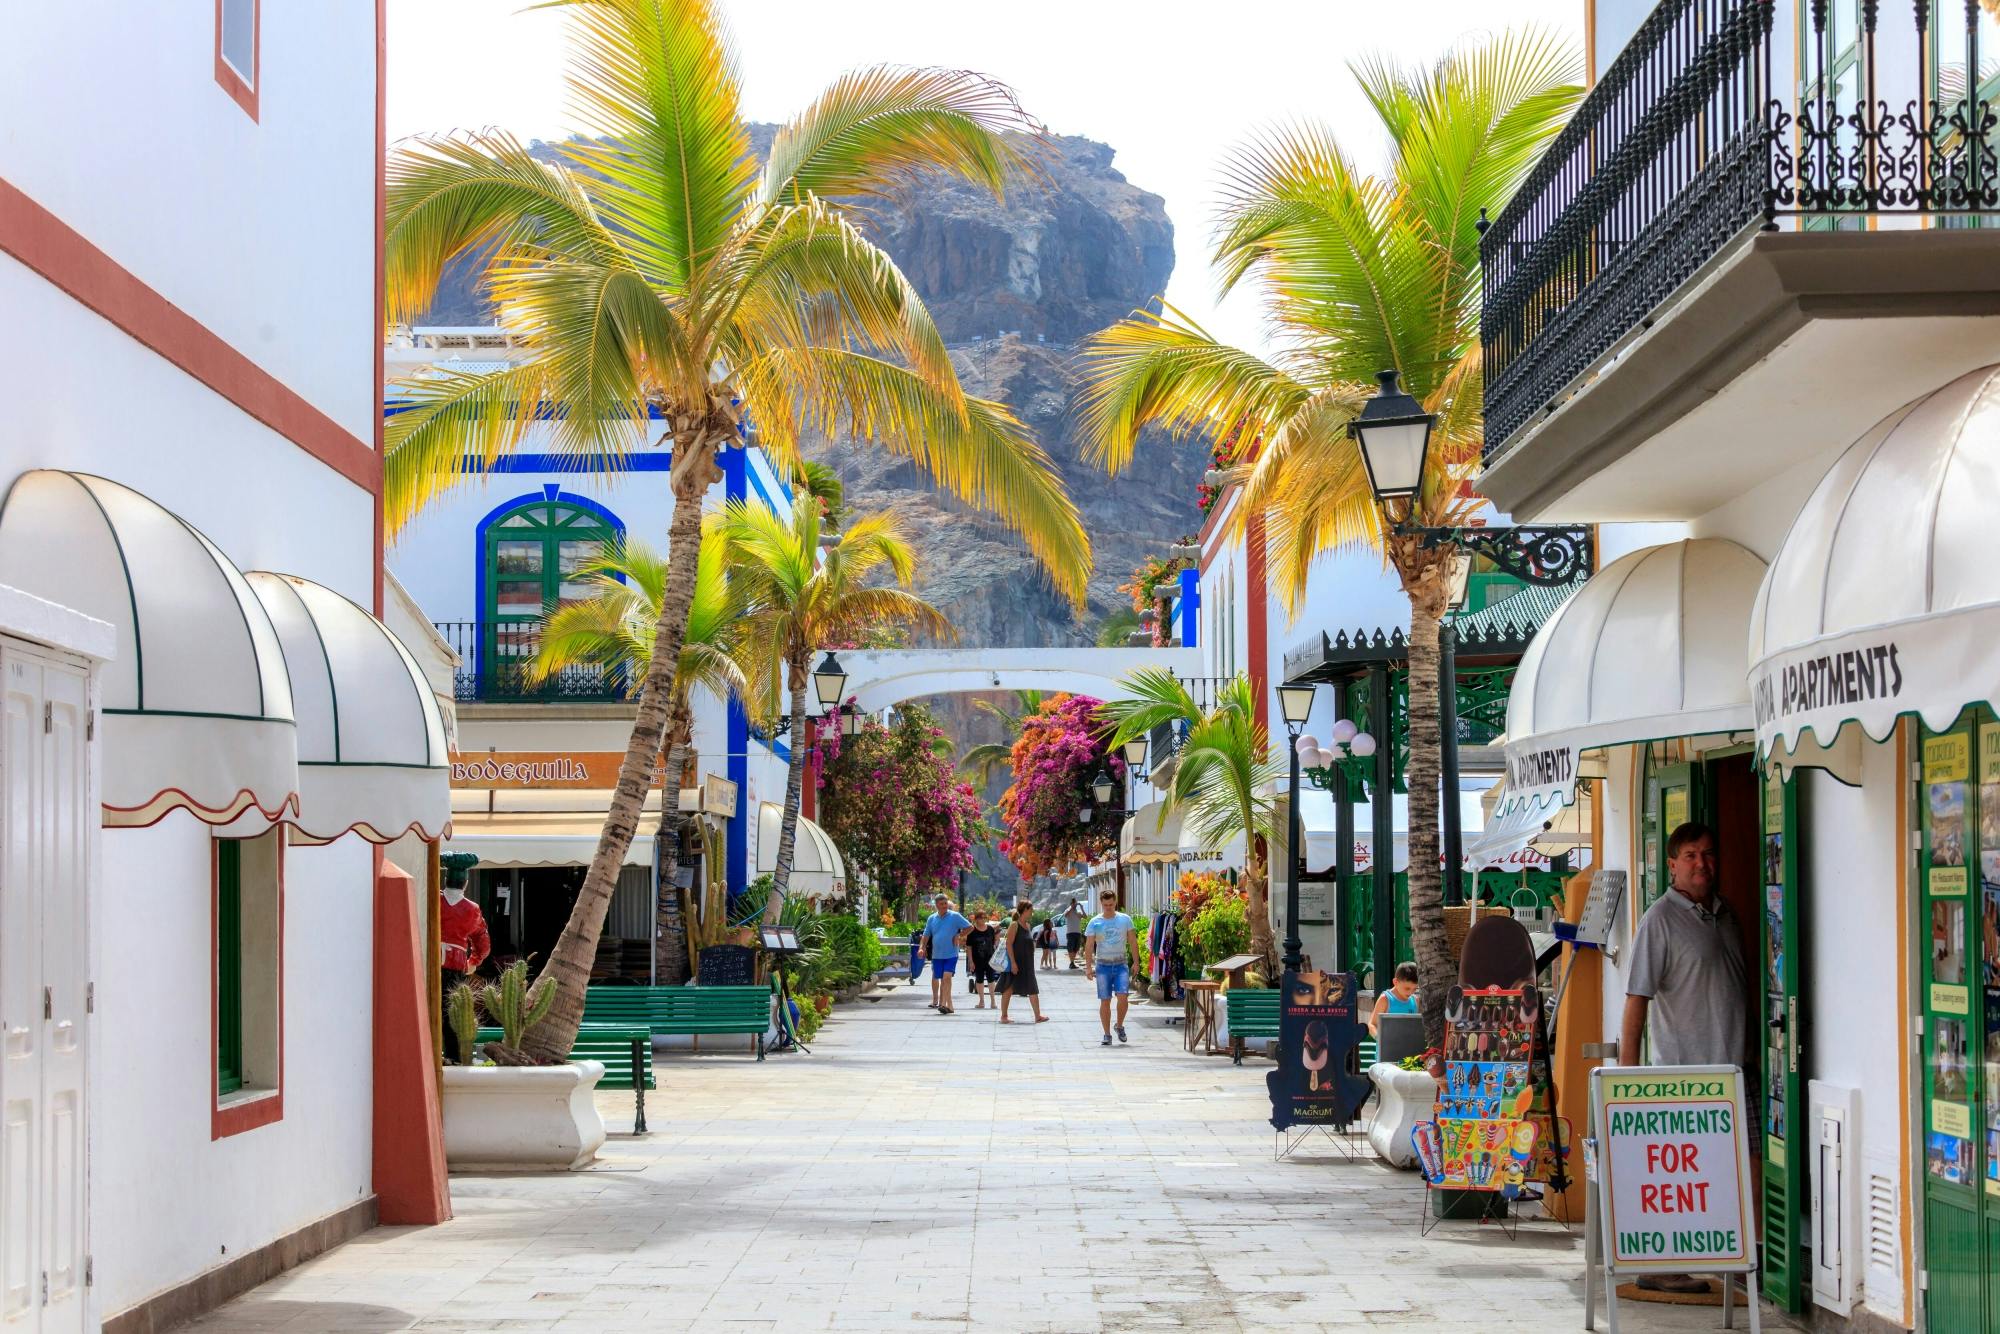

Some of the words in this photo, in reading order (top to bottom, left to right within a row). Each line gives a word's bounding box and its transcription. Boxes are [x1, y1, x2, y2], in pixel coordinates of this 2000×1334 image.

[1782, 642, 1902, 717] APARTMENTS
[1518, 746, 1572, 789] APARTMENTS
[1293, 1107, 1332, 1116] MAGNUM
[1611, 1109, 1731, 1136] APARTMENTS
[1646, 1143, 1699, 1174] FOR
[1640, 1182, 1710, 1214] RENT
[1620, 1231, 1665, 1254] INFO
[1673, 1230, 1737, 1253] INSIDE
